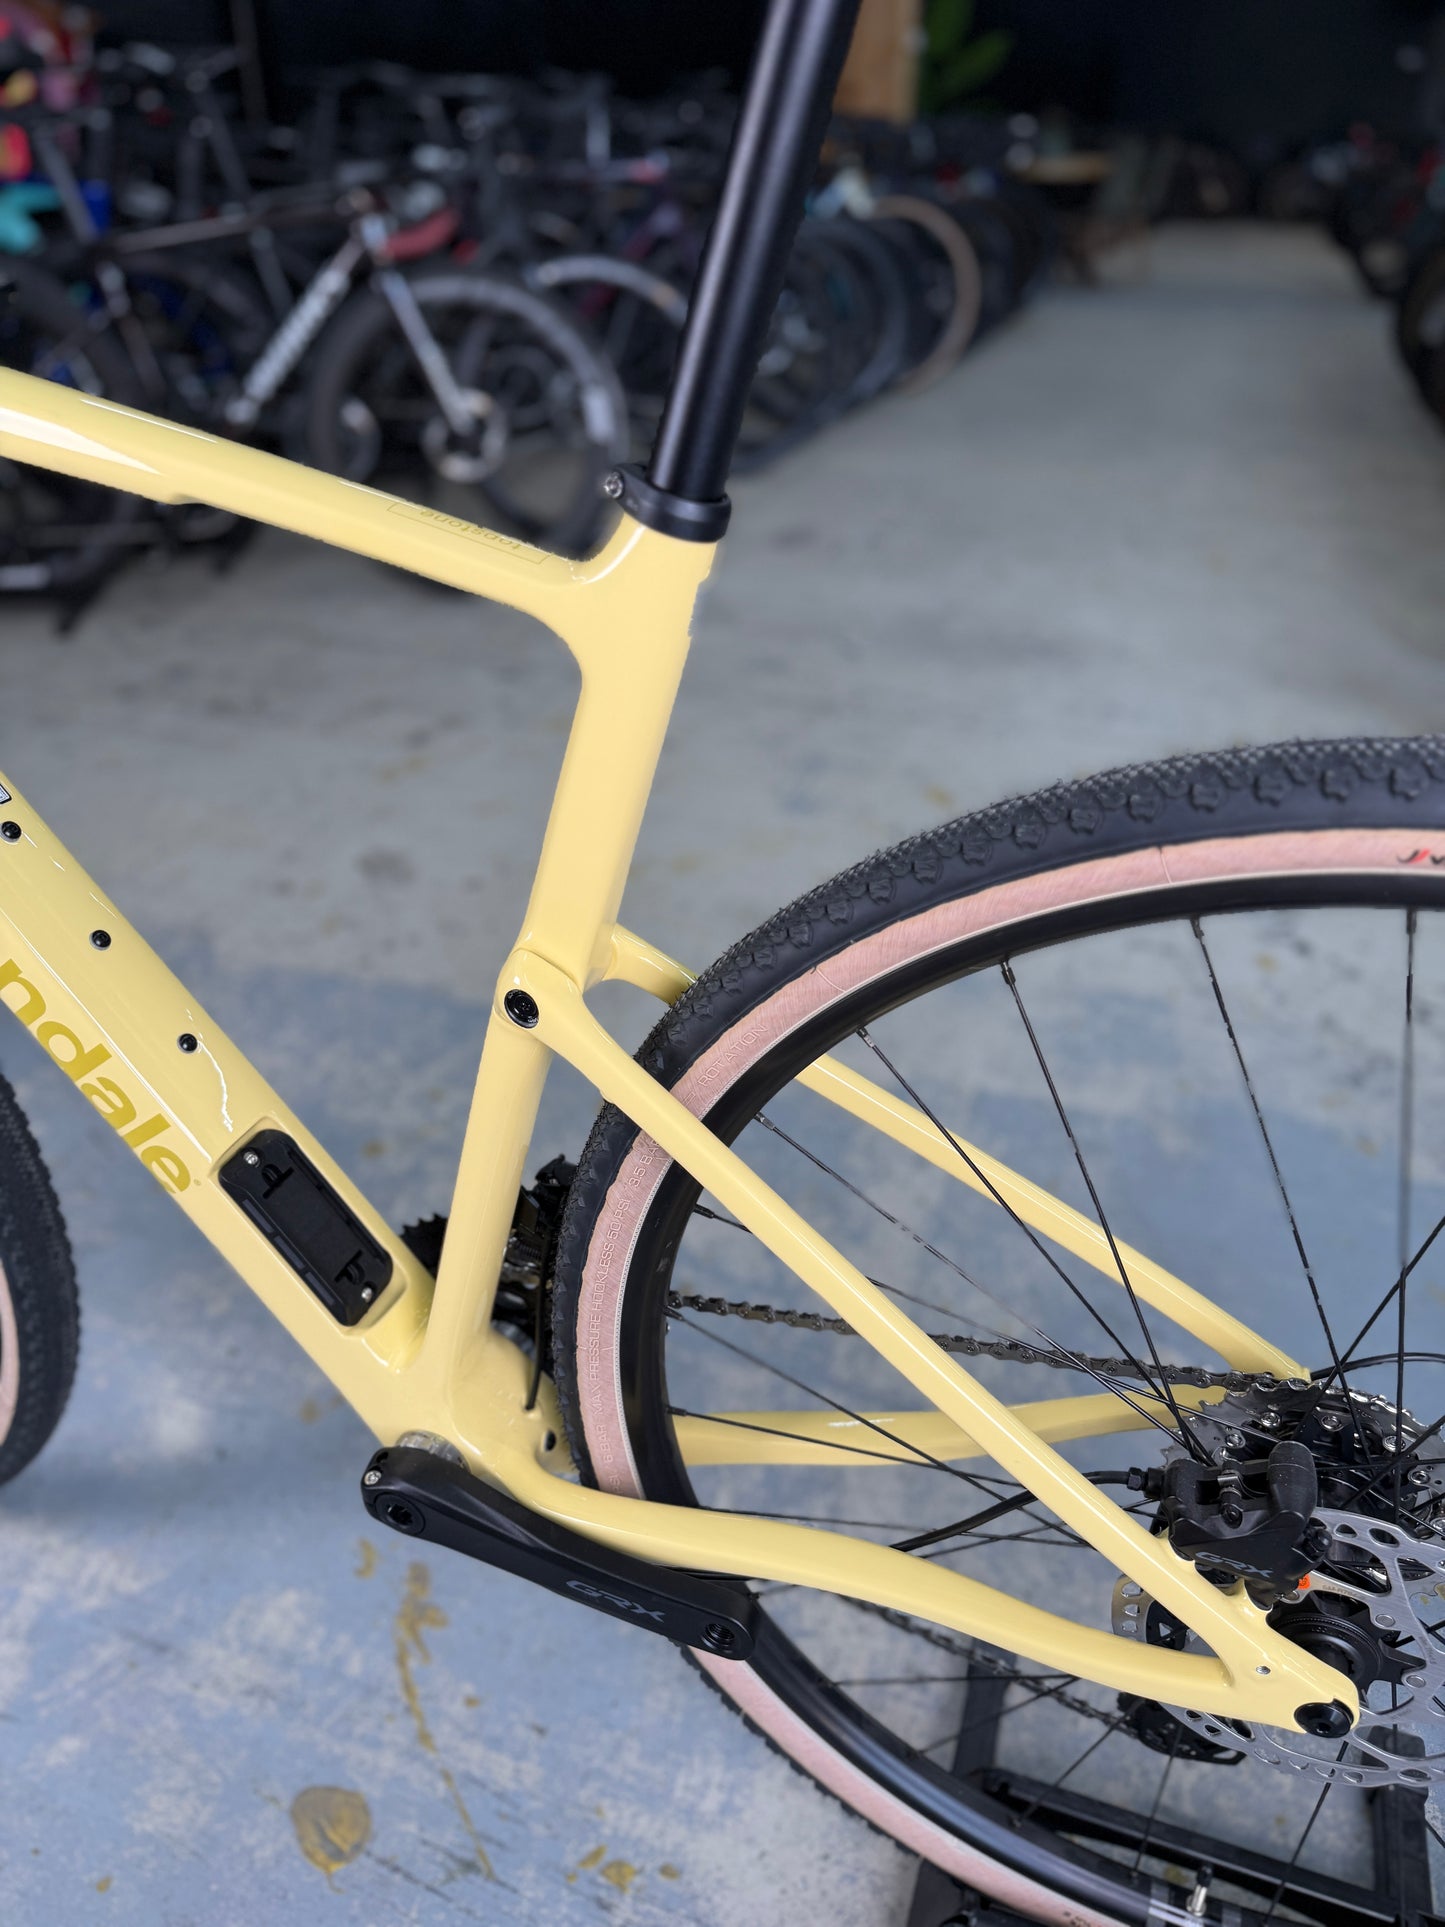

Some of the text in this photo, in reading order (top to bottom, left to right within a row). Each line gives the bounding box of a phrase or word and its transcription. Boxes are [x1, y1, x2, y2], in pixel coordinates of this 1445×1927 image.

[0, 958, 191, 1193] ndale
[697, 1023, 769, 1089] ROTATION
[614, 1197, 631, 1220] PSI
[591, 1241, 615, 1310] HOOKLESS
[589, 1313, 602, 1381] PRESSURE
[596, 1424, 614, 1451] BAR
[1195, 1551, 1274, 1578] GRX
[565, 1579, 666, 1624] GRX
